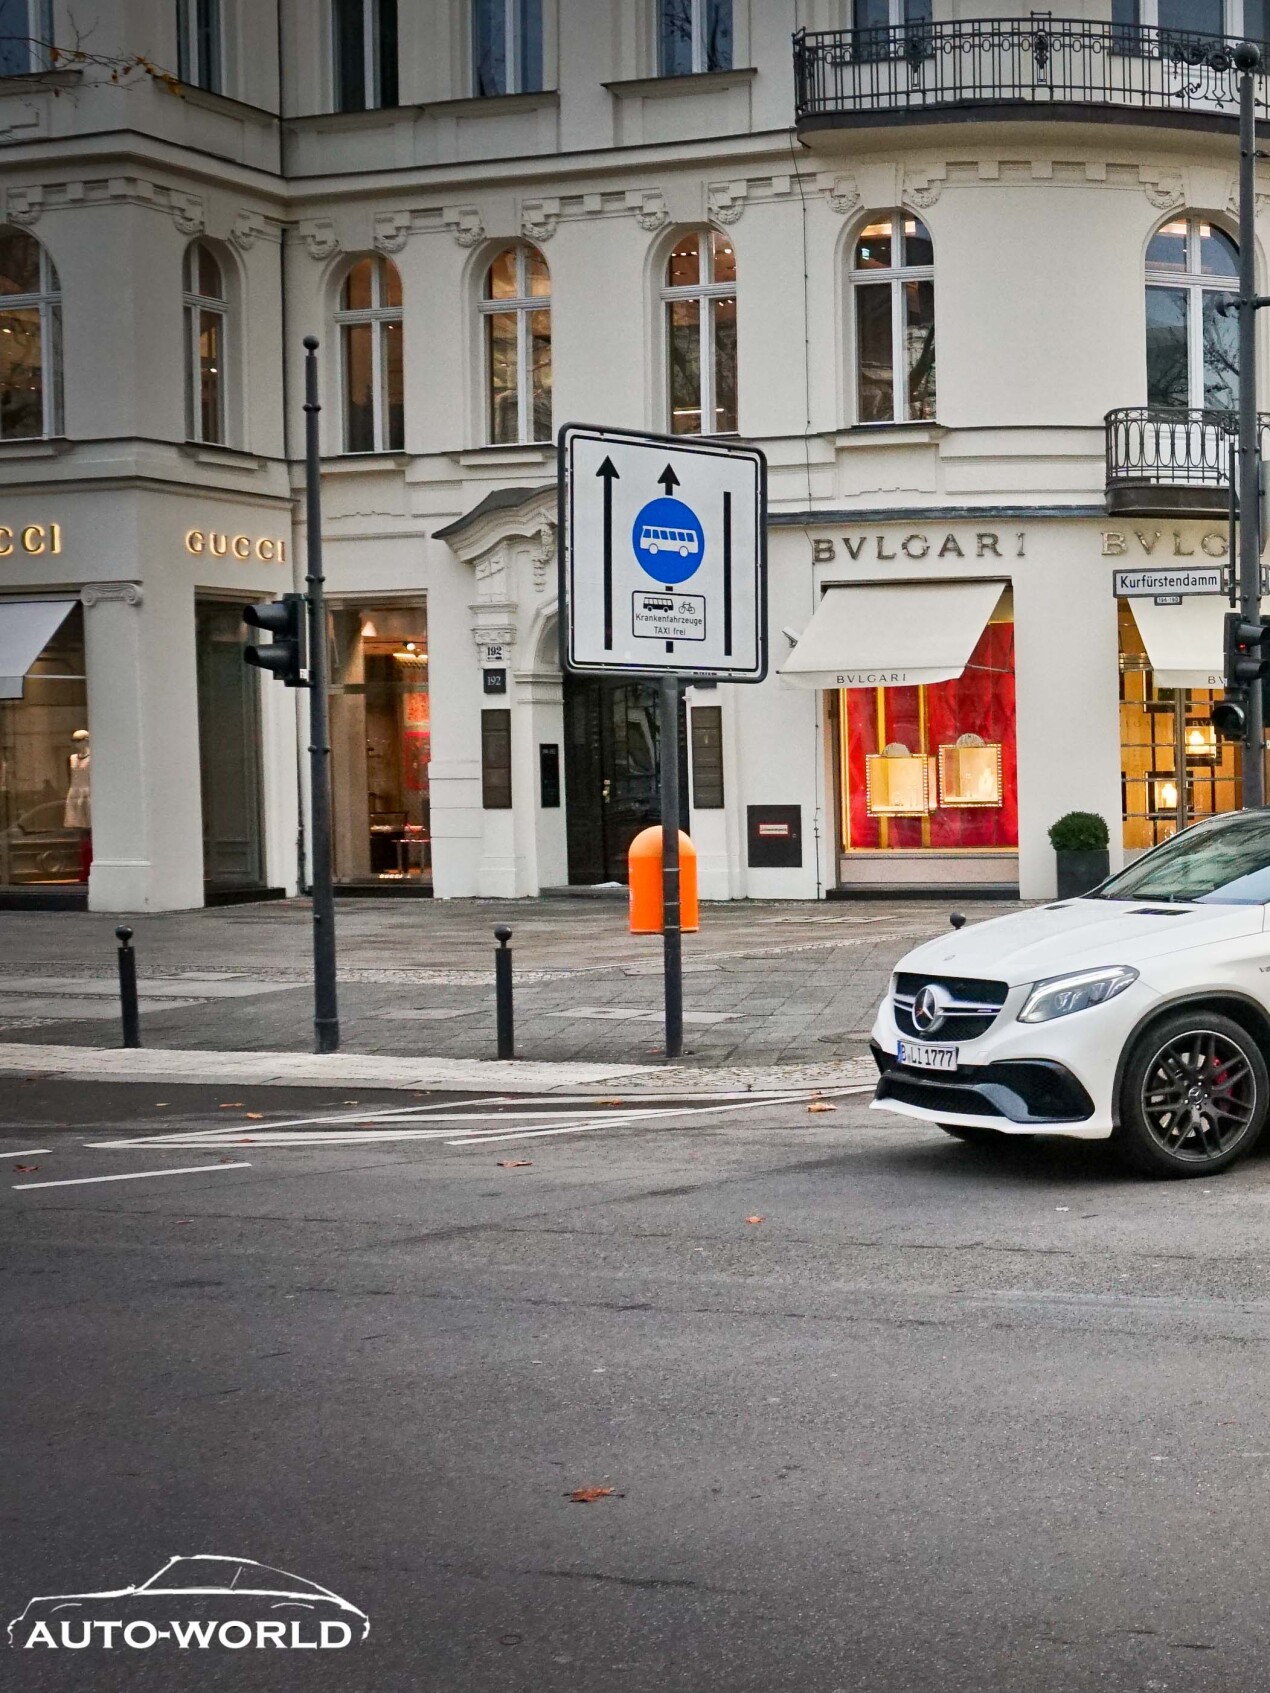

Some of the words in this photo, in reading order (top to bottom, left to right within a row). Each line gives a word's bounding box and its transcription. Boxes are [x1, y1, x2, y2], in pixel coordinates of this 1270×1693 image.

[186, 531, 286, 562] GUCCI
[812, 532, 1026, 562] BVLGARI
[1120, 573, 1218, 588] Kurfürstendamm
[635, 613, 703, 626] Krankenfahrzeuge
[654, 626, 670, 635] TAXI
[673, 628, 686, 636] frei
[487, 646, 502, 656] 192
[487, 675, 501, 686] 192
[836, 673, 907, 684] BVLGARI
[924, 1048, 953, 1068] 1777
